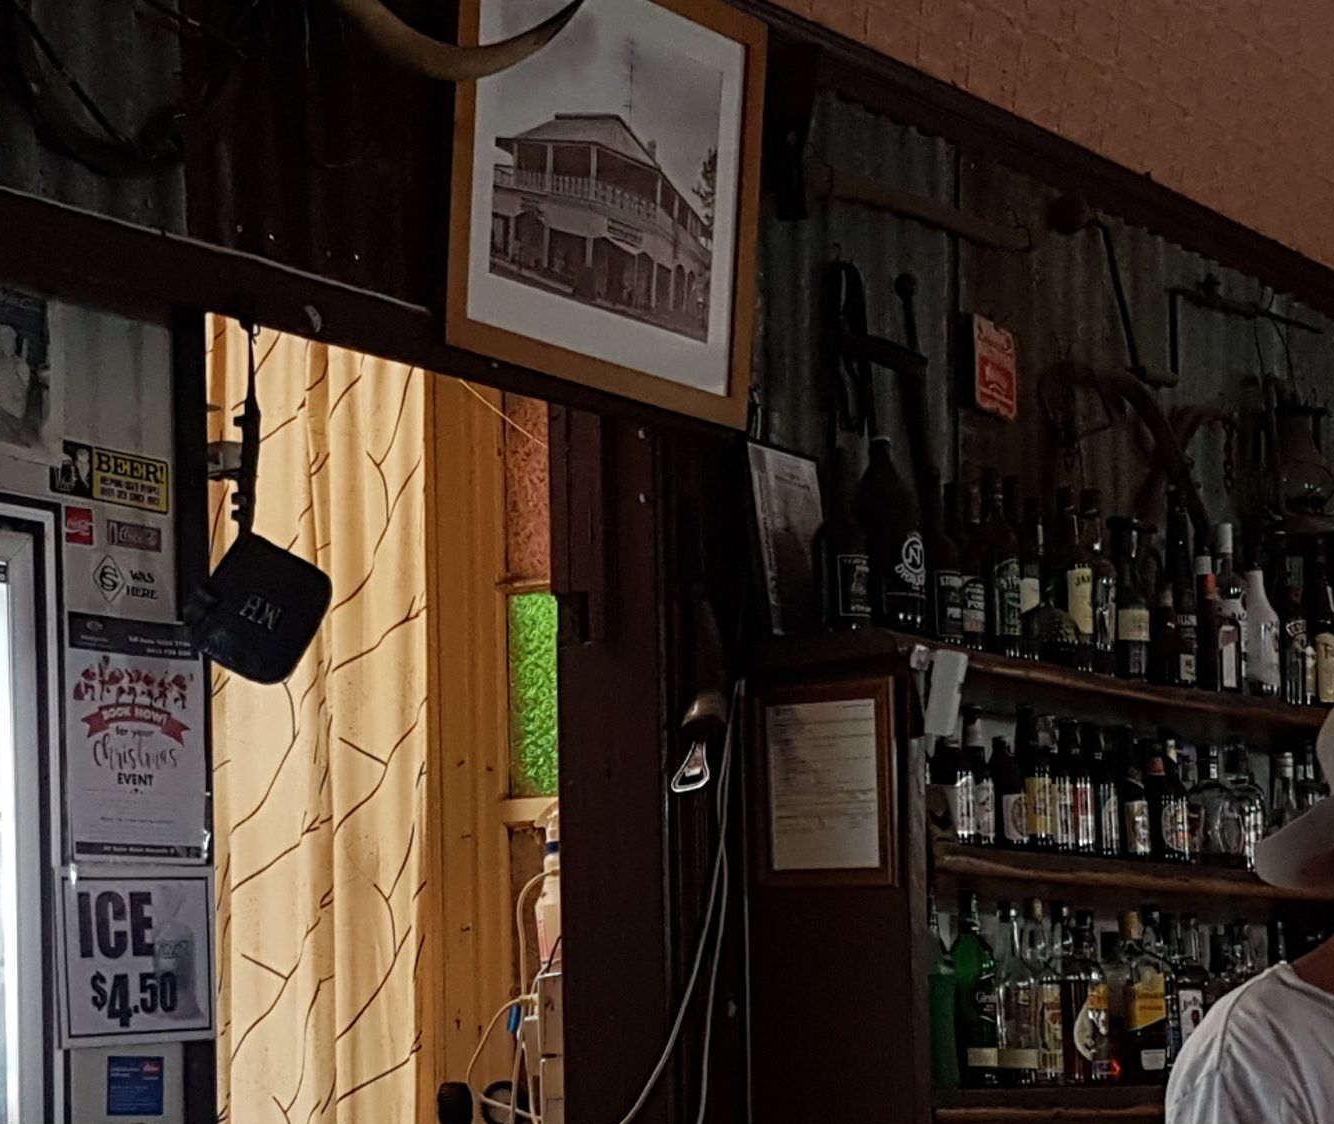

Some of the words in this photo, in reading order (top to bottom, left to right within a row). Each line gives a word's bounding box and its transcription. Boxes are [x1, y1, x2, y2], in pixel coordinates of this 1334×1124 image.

[96, 452, 164, 484] BEER!
[117, 772, 153, 786] EVENT
[77, 891, 155, 958] ICE
[90, 971, 178, 1027] $4.50
